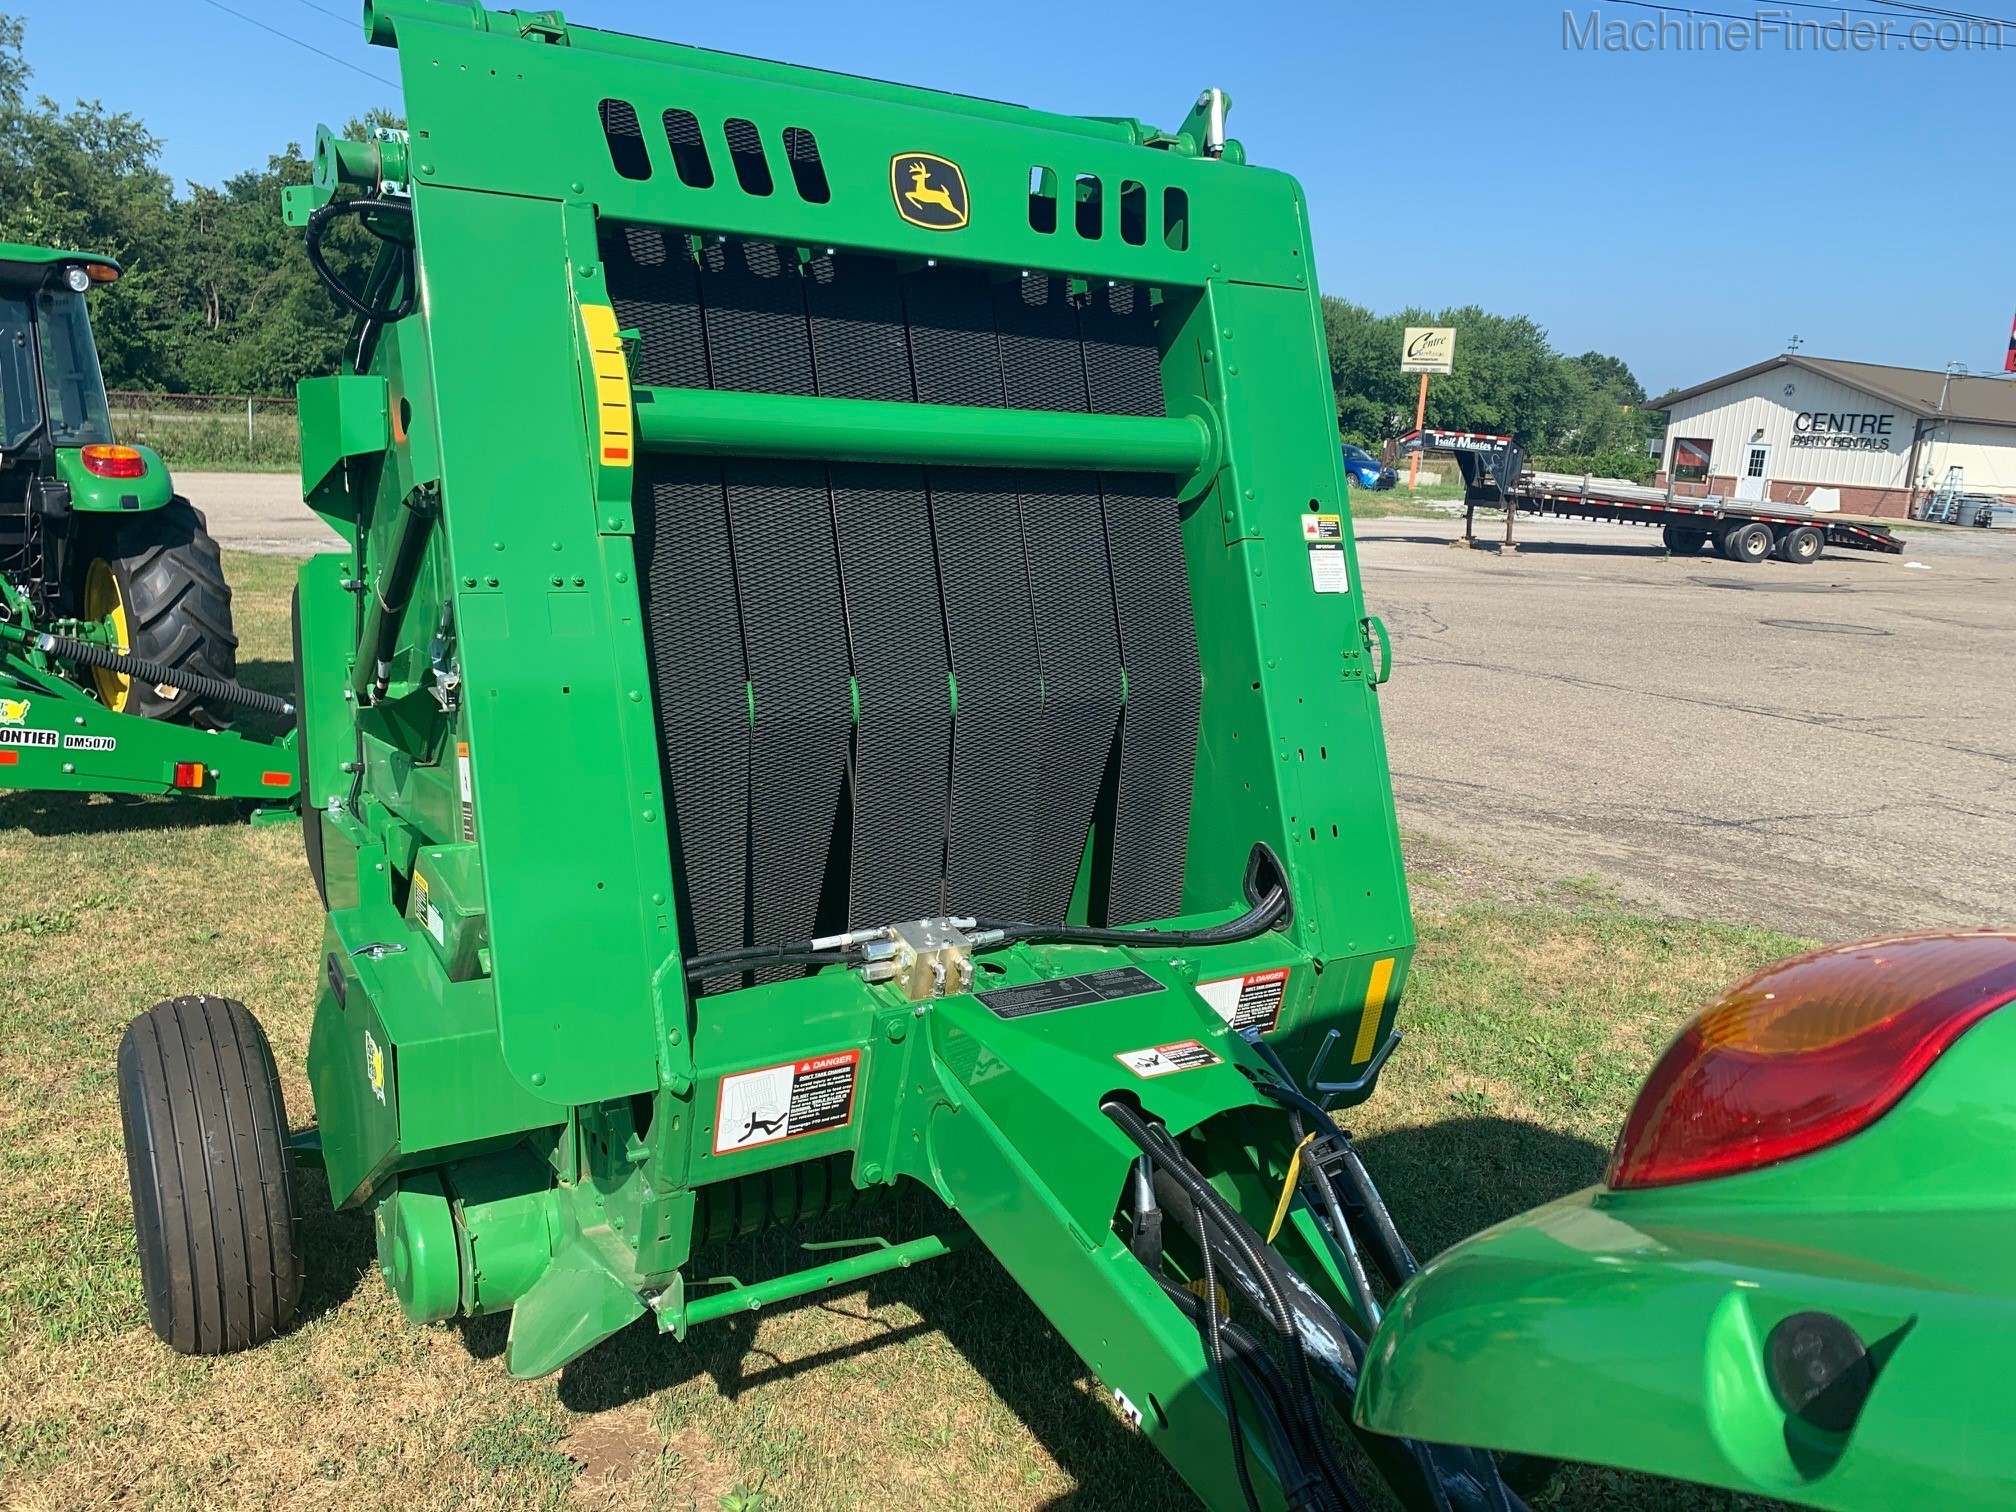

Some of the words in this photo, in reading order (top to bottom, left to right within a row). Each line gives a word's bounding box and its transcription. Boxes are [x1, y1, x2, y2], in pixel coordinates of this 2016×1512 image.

[1408, 332, 1447, 357] Centre
[1795, 412, 1895, 435] CENTRE
[1433, 433, 1456, 447] Trail
[1457, 437, 1492, 451] Master
[1792, 435, 1831, 446] PARTY
[1833, 436, 1890, 450] RENTALS
[65, 737, 115, 749] DM5070
[1255, 972, 1284, 983] DANGER
[813, 1055, 852, 1069] DANGER
